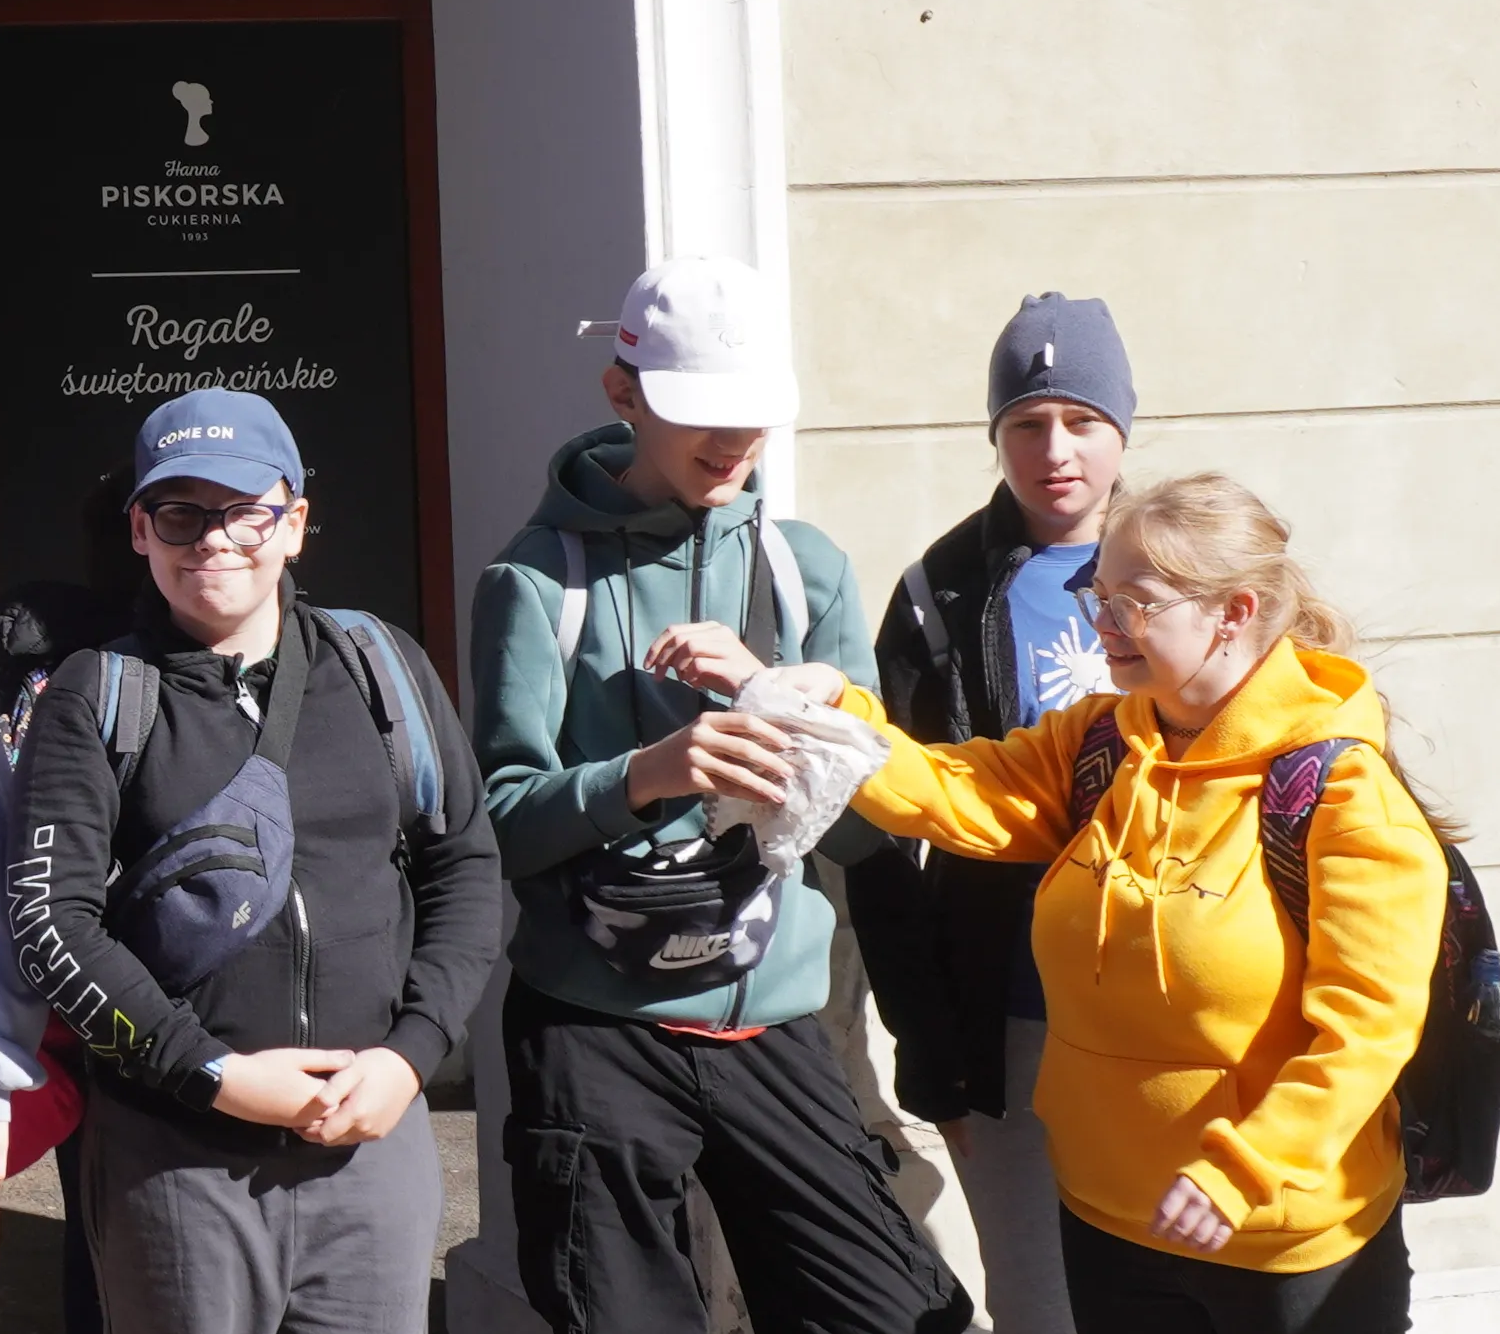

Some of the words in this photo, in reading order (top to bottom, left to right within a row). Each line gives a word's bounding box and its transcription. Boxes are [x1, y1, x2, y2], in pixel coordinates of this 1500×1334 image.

[165, 159, 221, 177] Hanna
[147, 214, 242, 226] CUKIERNIA
[182, 232, 209, 241] 1993
[127, 304, 273, 361] Rogale
[61, 356, 337, 404] świętomarcińskie
[157, 426, 202, 449] COME
[207, 425, 234, 440] ON
[661, 931, 731, 958] NIKE
